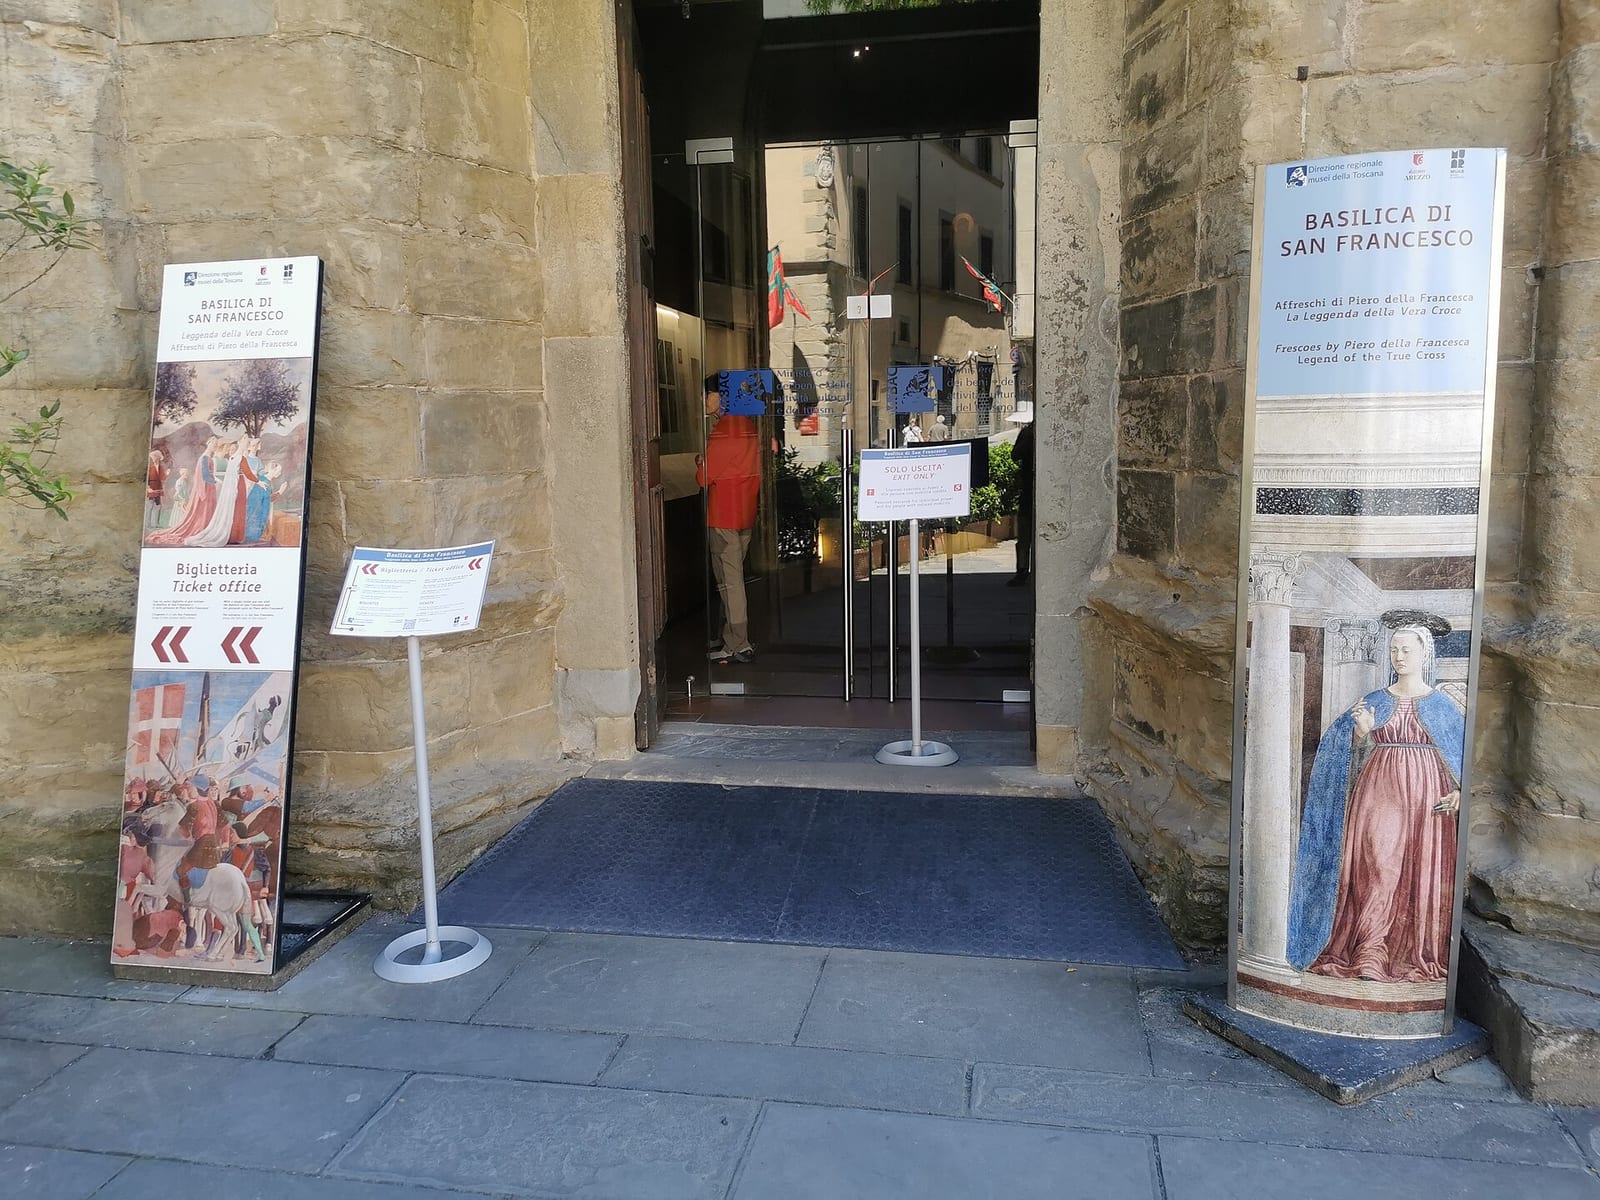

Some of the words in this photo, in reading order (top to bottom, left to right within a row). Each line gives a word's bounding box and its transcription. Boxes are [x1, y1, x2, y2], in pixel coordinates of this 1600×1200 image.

[1308, 163, 1345, 174] Direzione
[1346, 159, 1383, 171] regionale
[1308, 175, 1331, 184] musei
[1331, 172, 1351, 182] della
[1352, 170, 1384, 180] Toscana
[1305, 206, 1416, 231] BASILICA
[1427, 205, 1452, 222] DI
[1281, 237, 1325, 257] SAN
[1336, 229, 1473, 252] FRANCESCO
[201, 298, 254, 309] BASILICA
[259, 297, 272, 307] DI
[1275, 298, 1326, 310] Affreschi
[1331, 296, 1343, 306] di
[1348, 295, 1379, 306] Piero
[1385, 294, 1415, 304] della
[1420, 292, 1474, 303] Francesca
[188, 314, 211, 324] SAN
[216, 311, 284, 322] FRANCESCO
[1286, 312, 1299, 322] La
[1303, 309, 1359, 323] Leggenda
[1364, 307, 1395, 317] della
[1401, 306, 1426, 316] Vera
[1432, 305, 1462, 315] Croce
[181, 330, 219, 341] Leggenda
[222, 329, 242, 338] della
[245, 329, 263, 337] Vera
[266, 327, 289, 336] Croce
[170, 343, 205, 351] Affreschi
[208, 342, 215, 350] di
[218, 342, 237, 350] Piero
[240, 341, 259, 349] della
[262, 340, 298, 348] Francesca
[1275, 342, 1321, 353] Frescoes
[1326, 341, 1340, 353] by
[1344, 340, 1375, 350] Piero
[1381, 338, 1411, 348] della
[1415, 337, 1470, 347] Francesca
[1298, 354, 1338, 365] Legend
[1344, 353, 1357, 362] of
[1362, 352, 1381, 362] the
[1386, 351, 1411, 361] True
[1416, 350, 1446, 360] Cross
[776, 369, 823, 378] Ministeo
[1001, 376, 1026, 386] dee
[946, 390, 984, 401] attivit
[884, 465, 908, 473] SOLO
[892, 473, 910, 481] EXIT
[913, 472, 935, 480] ONLY
[436, 549, 467, 557] Francesco
[176, 563, 258, 578] Biglietteria
[380, 566, 418, 574] Biglietteria
[172, 580, 213, 592] Ticket
[219, 580, 262, 592] office
